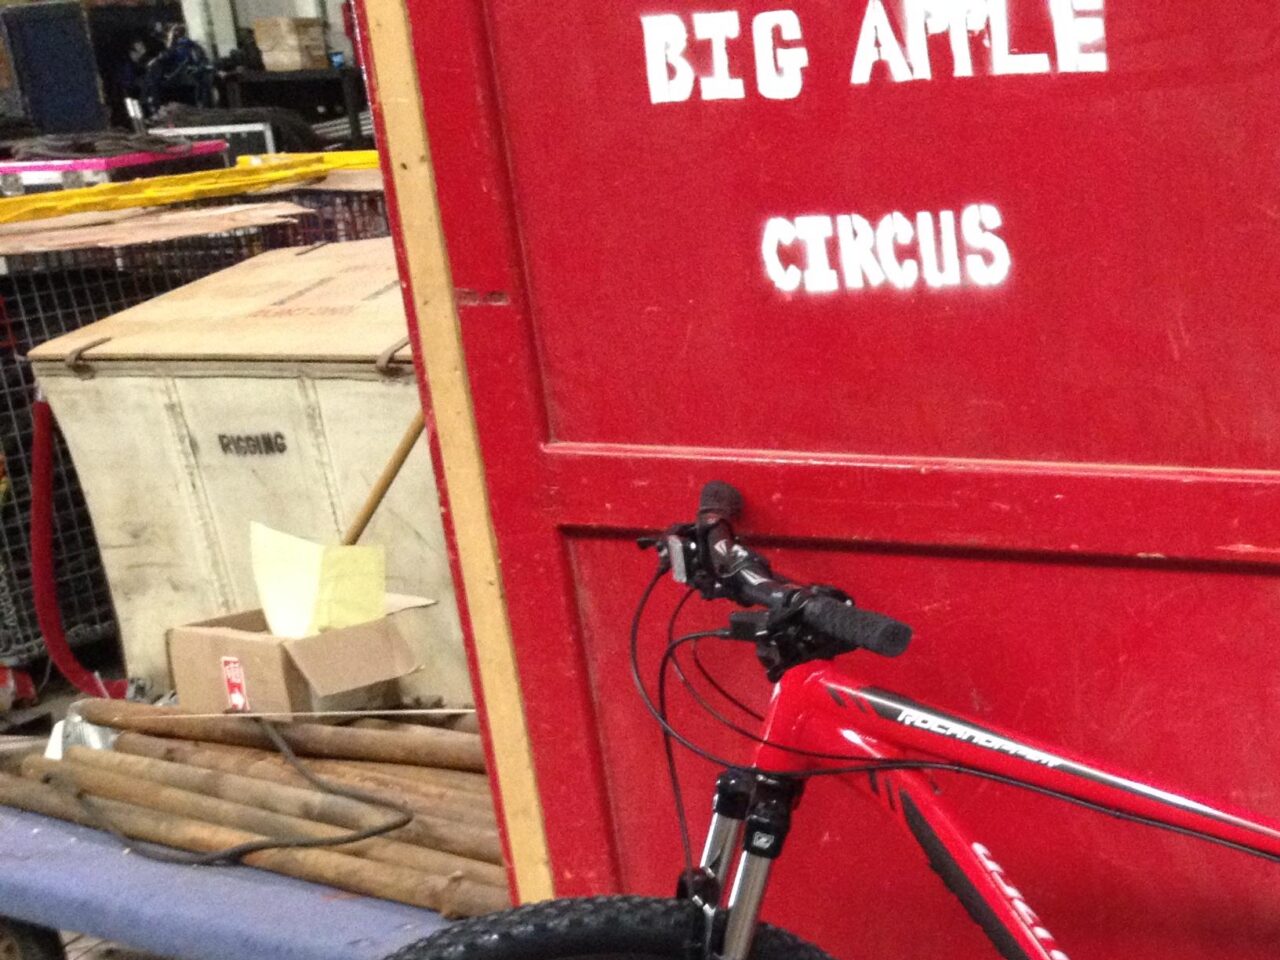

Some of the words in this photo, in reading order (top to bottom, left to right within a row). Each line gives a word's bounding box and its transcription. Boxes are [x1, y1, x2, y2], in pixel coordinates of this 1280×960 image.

[641, 10, 809, 104] BIG
[850, 0, 1109, 84] APPLE
[761, 203, 1012, 293] CIRCUS
